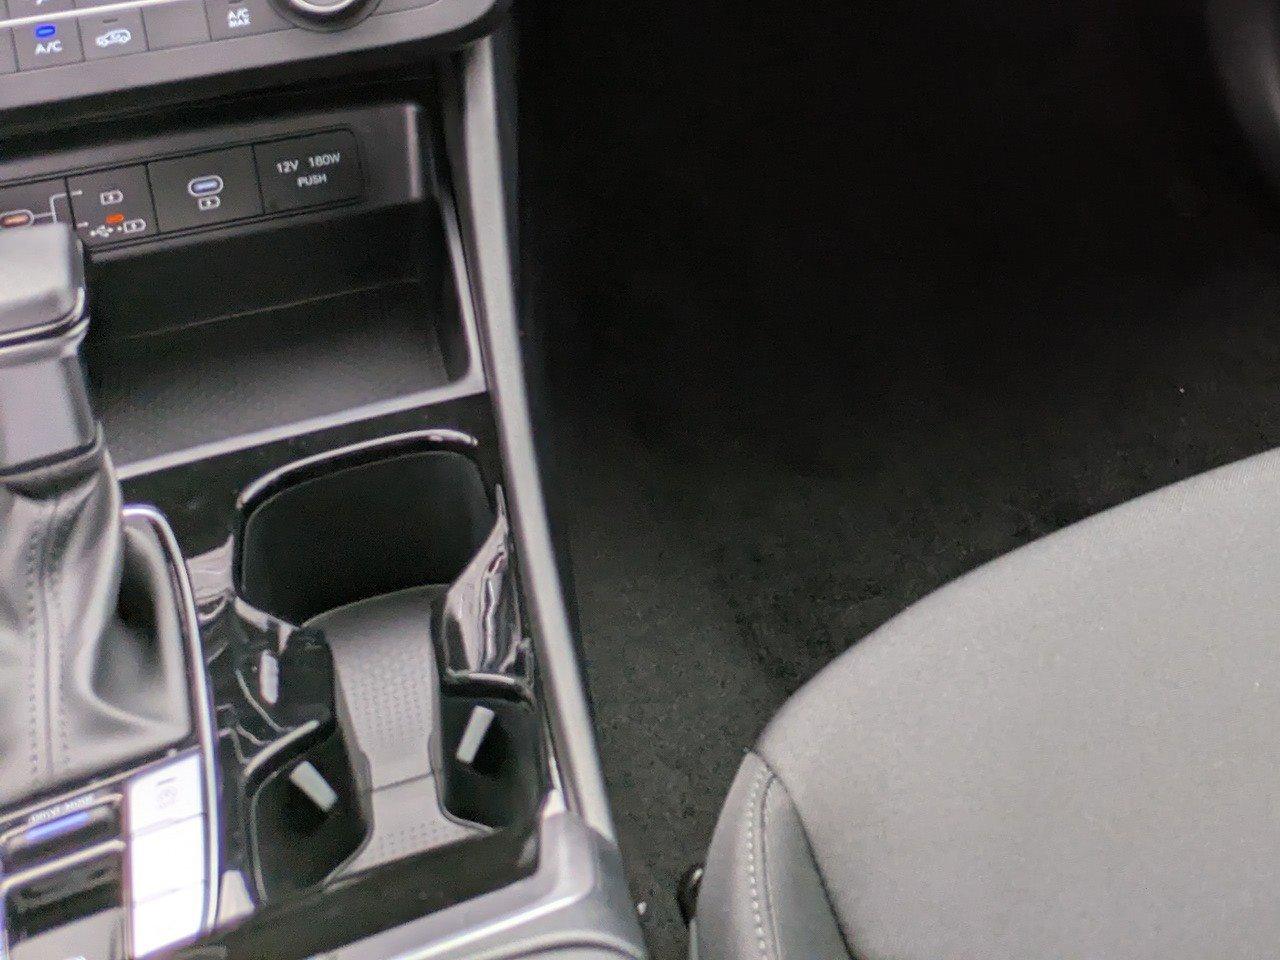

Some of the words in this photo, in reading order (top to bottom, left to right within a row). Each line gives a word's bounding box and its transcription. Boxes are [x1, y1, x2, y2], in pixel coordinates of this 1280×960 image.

[227, 7, 250, 21] A/C
[35, 40, 63, 55] A/C
[276, 159, 299, 174] 12V
[308, 151, 341, 168] 180W
[297, 173, 328, 188] PUSH
